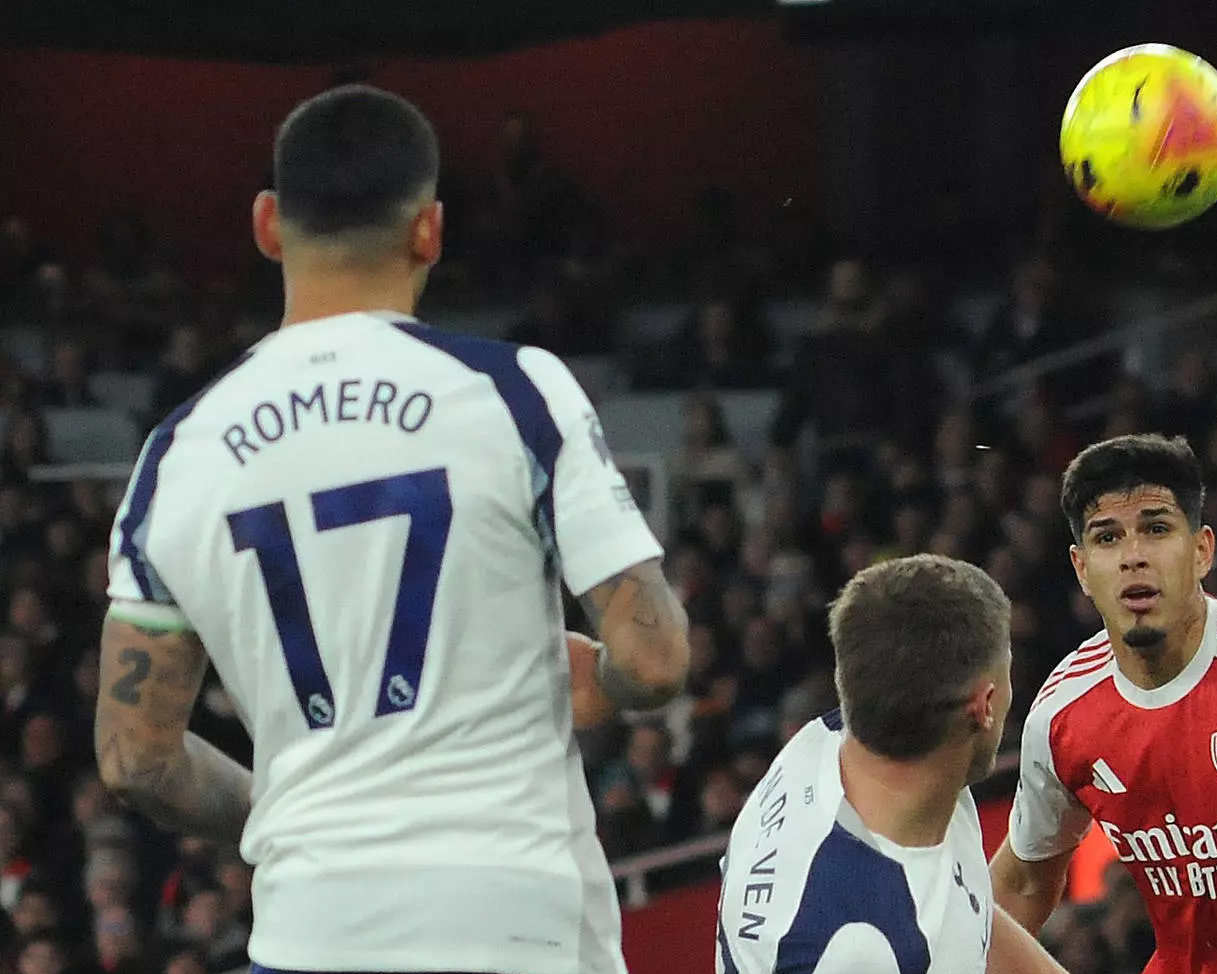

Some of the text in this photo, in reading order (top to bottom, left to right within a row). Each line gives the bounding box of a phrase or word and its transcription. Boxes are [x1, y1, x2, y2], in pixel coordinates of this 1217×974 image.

[222, 378, 433, 466] ROMERO
[226, 467, 453, 729] 17
[738, 848, 777, 940] VEN
[1145, 866, 1183, 896] FLY
